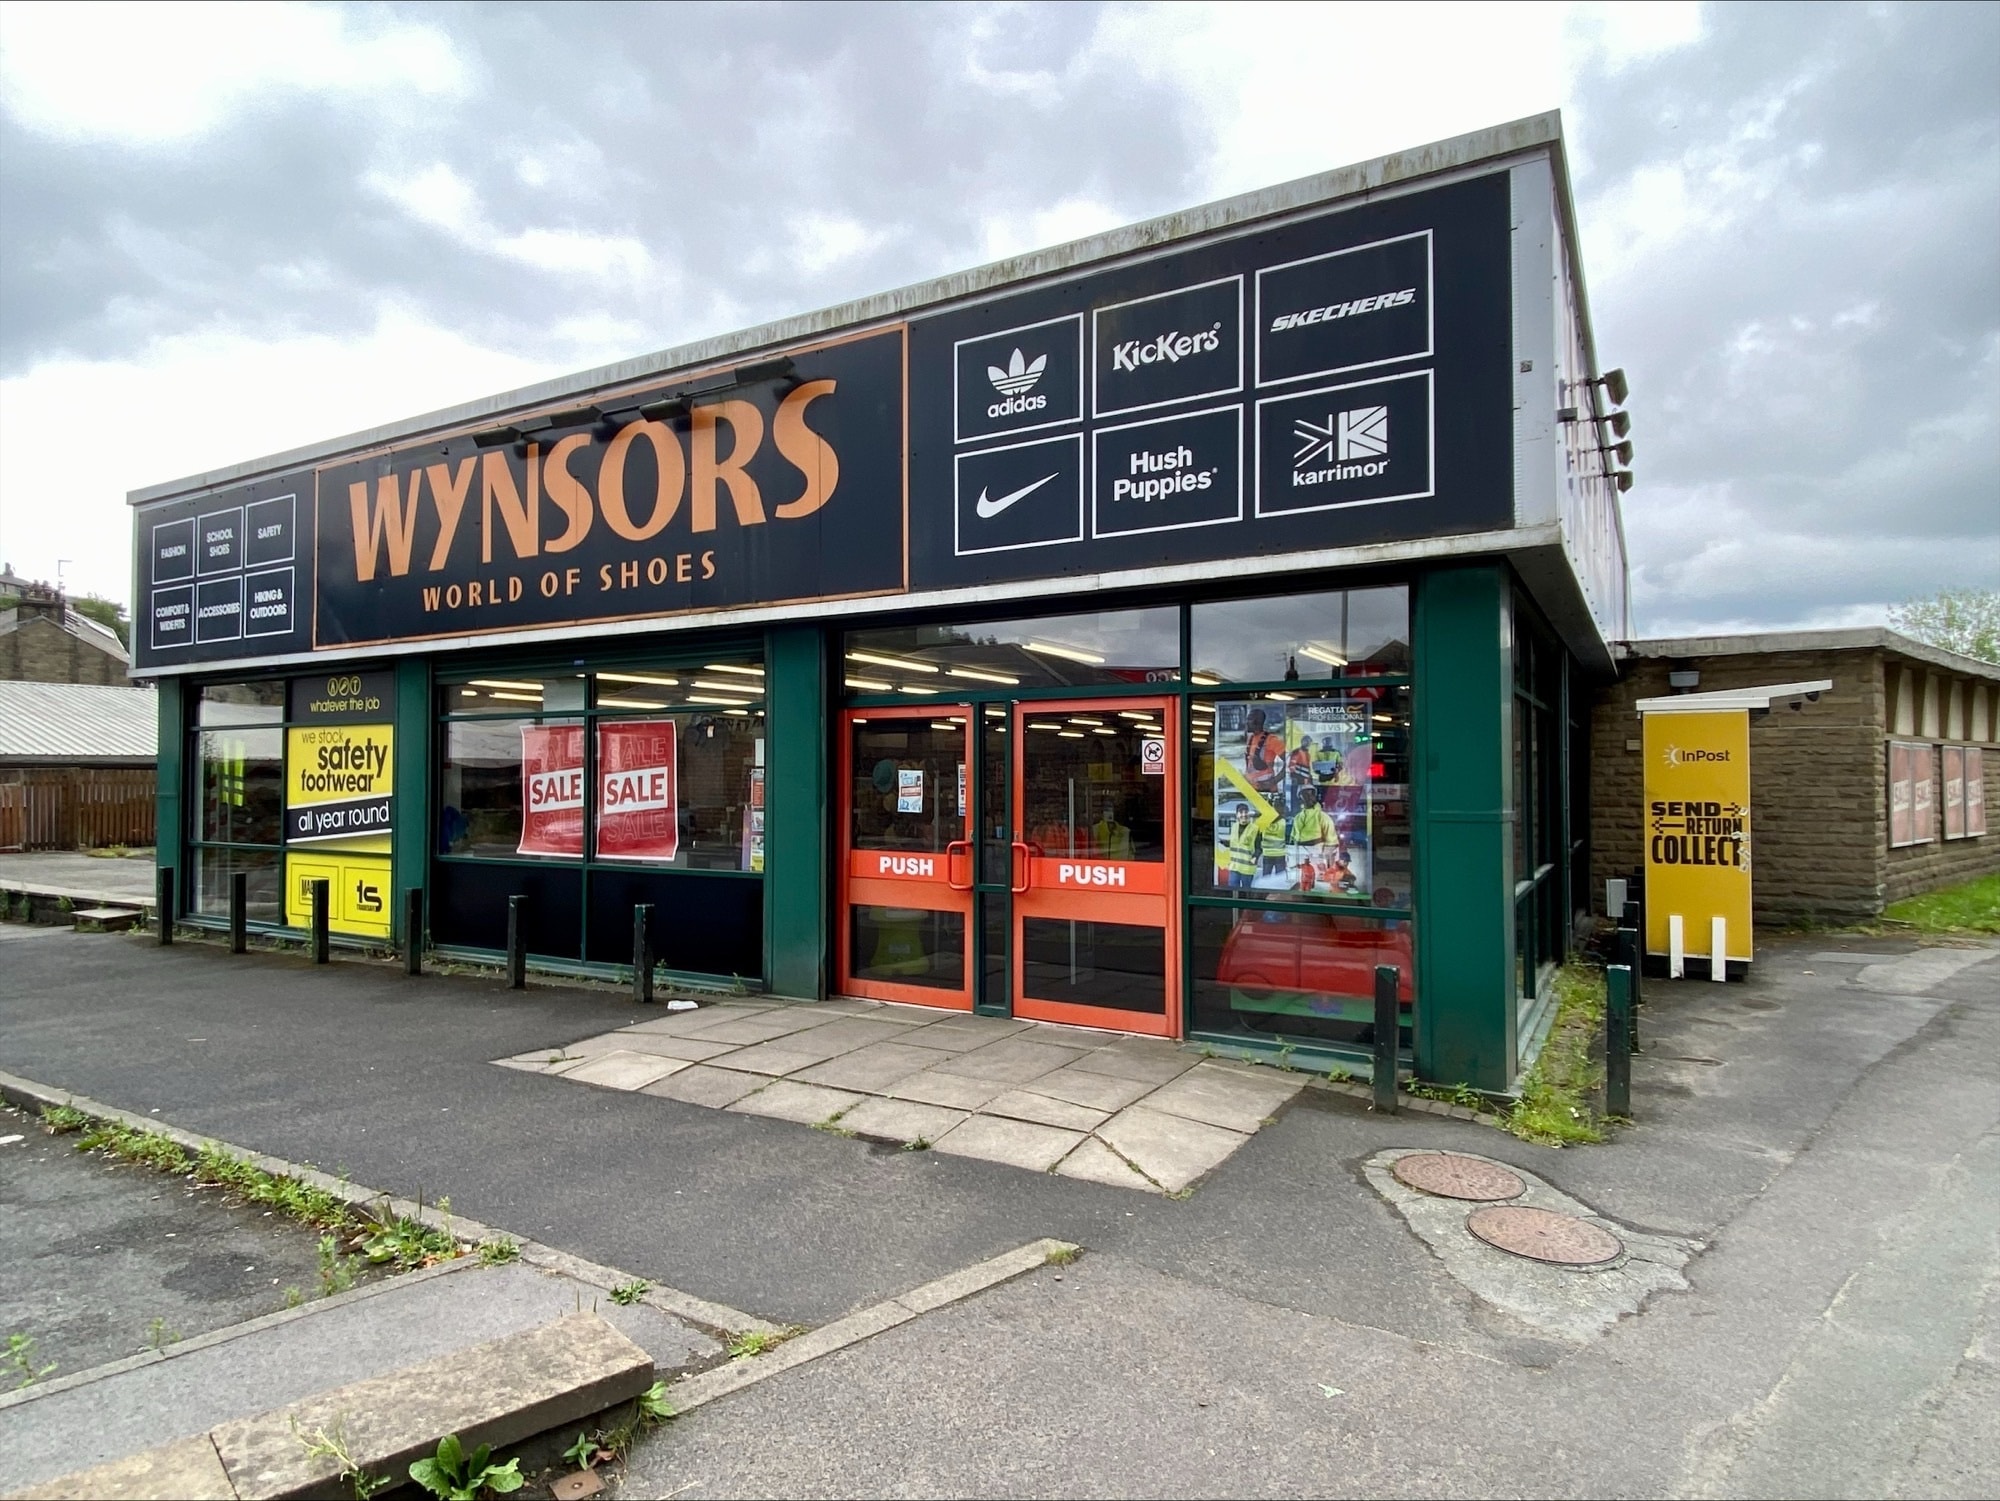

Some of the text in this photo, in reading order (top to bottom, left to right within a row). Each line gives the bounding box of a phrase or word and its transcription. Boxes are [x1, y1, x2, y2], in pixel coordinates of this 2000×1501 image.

[1270, 288, 1416, 332] SKECHERS
[987, 395, 1047, 418] adidas
[1130, 446, 1192, 475] Hush
[350, 379, 839, 582] WYNSORS
[1293, 461, 1388, 487] karrimor
[1114, 470, 1213, 502] Puppies
[206, 528, 233, 543] SCHOOL
[258, 524, 282, 539] SAFETY
[161, 545, 187, 559] FASHION
[209, 543, 230, 557] SHOES
[422, 550, 716, 612] WORLD OF SHOES
[254, 590, 277, 604] HIKING
[155, 604, 186, 618] COMFORT
[199, 602, 240, 619] ACCESSORIES
[250, 604, 287, 619] OUTDOORS
[310, 696, 380, 713] whatever the job
[1308, 706, 1346, 714] REGATTA
[302, 728, 344, 744] we stock
[317, 738, 388, 778] safety
[1682, 750, 1730, 762] InPost
[301, 768, 374, 792] footwear
[531, 773, 582, 805] SALE
[606, 773, 665, 806] SALE
[298, 800, 389, 834] all year round
[1651, 801, 1721, 817] SEND
[606, 811, 667, 843] SALE
[1686, 818, 1743, 835] RETURN
[1651, 835, 1744, 867] COLLECT
[879, 856, 934, 876] PUSH
[1059, 864, 1125, 886] PUSH
